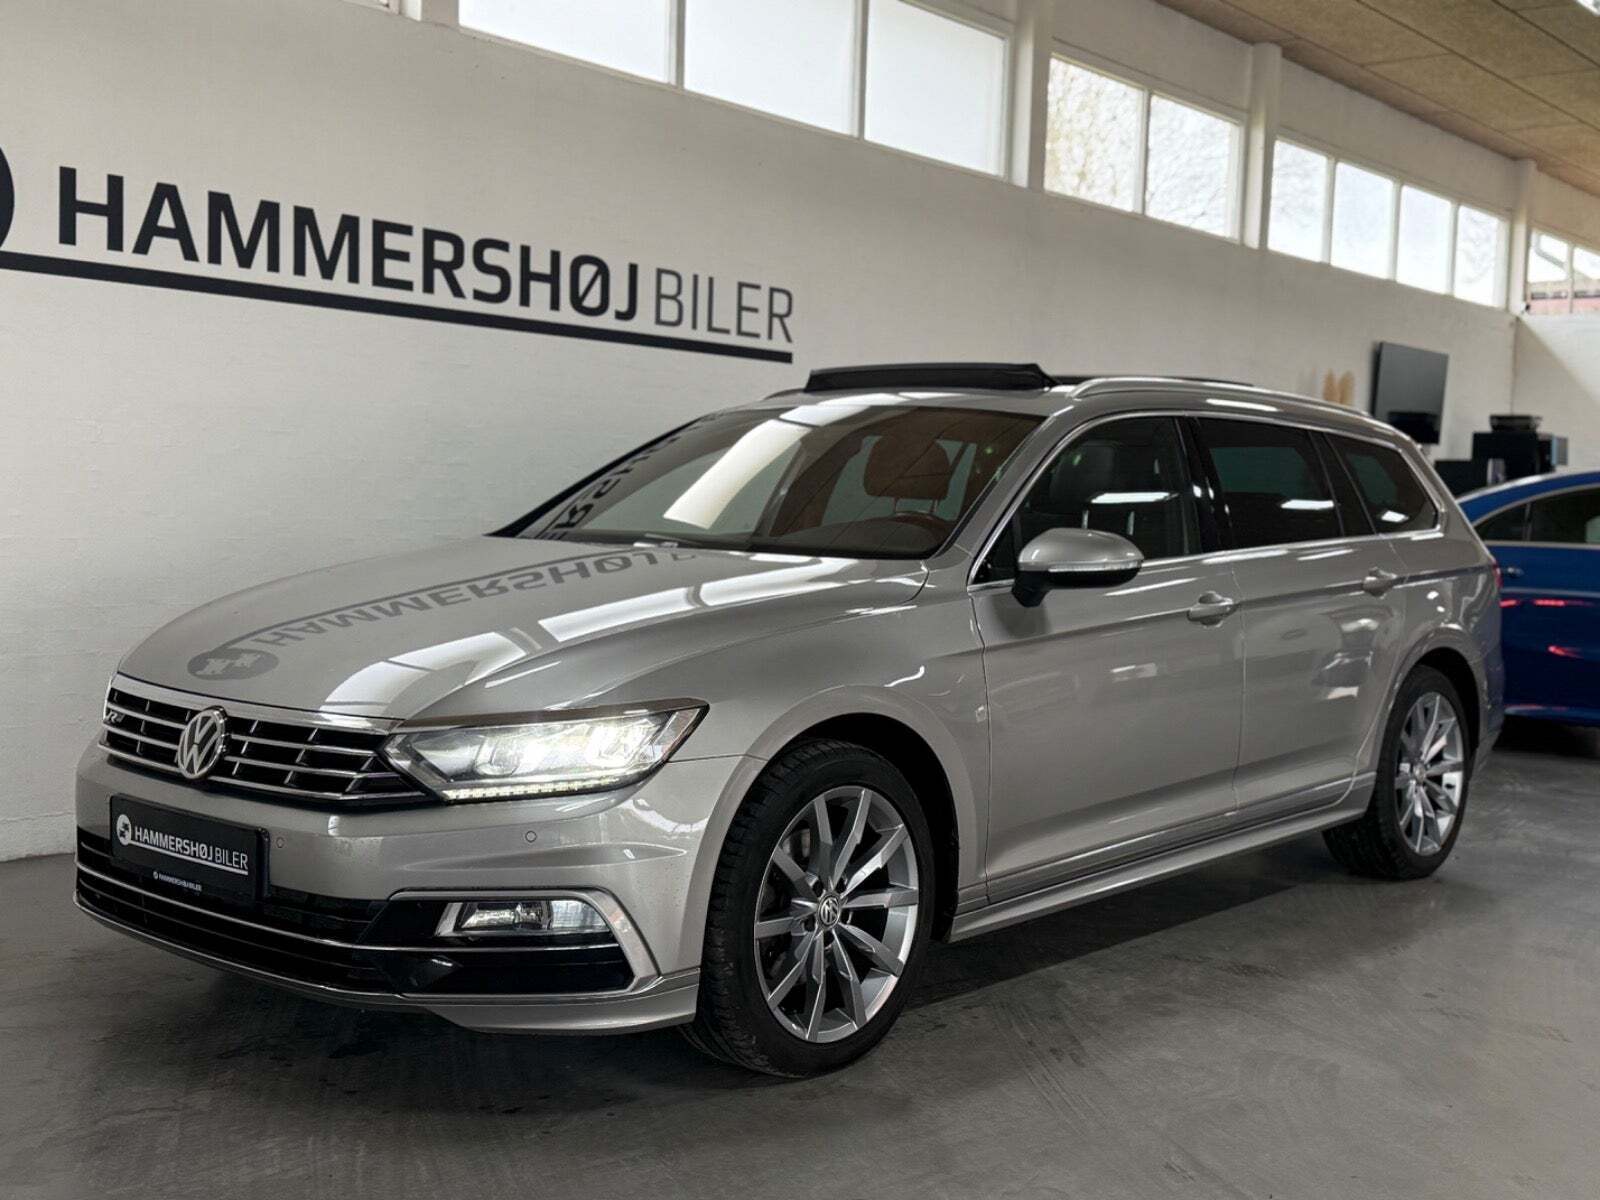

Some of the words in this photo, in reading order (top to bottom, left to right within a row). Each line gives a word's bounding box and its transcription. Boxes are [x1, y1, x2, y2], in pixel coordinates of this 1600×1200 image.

[58, 165, 639, 328] HAMMERSHØJ
[655, 267, 793, 343] BILER
[134, 826, 213, 861] HAMMERSHØJ
[214, 847, 249, 870] BILER
